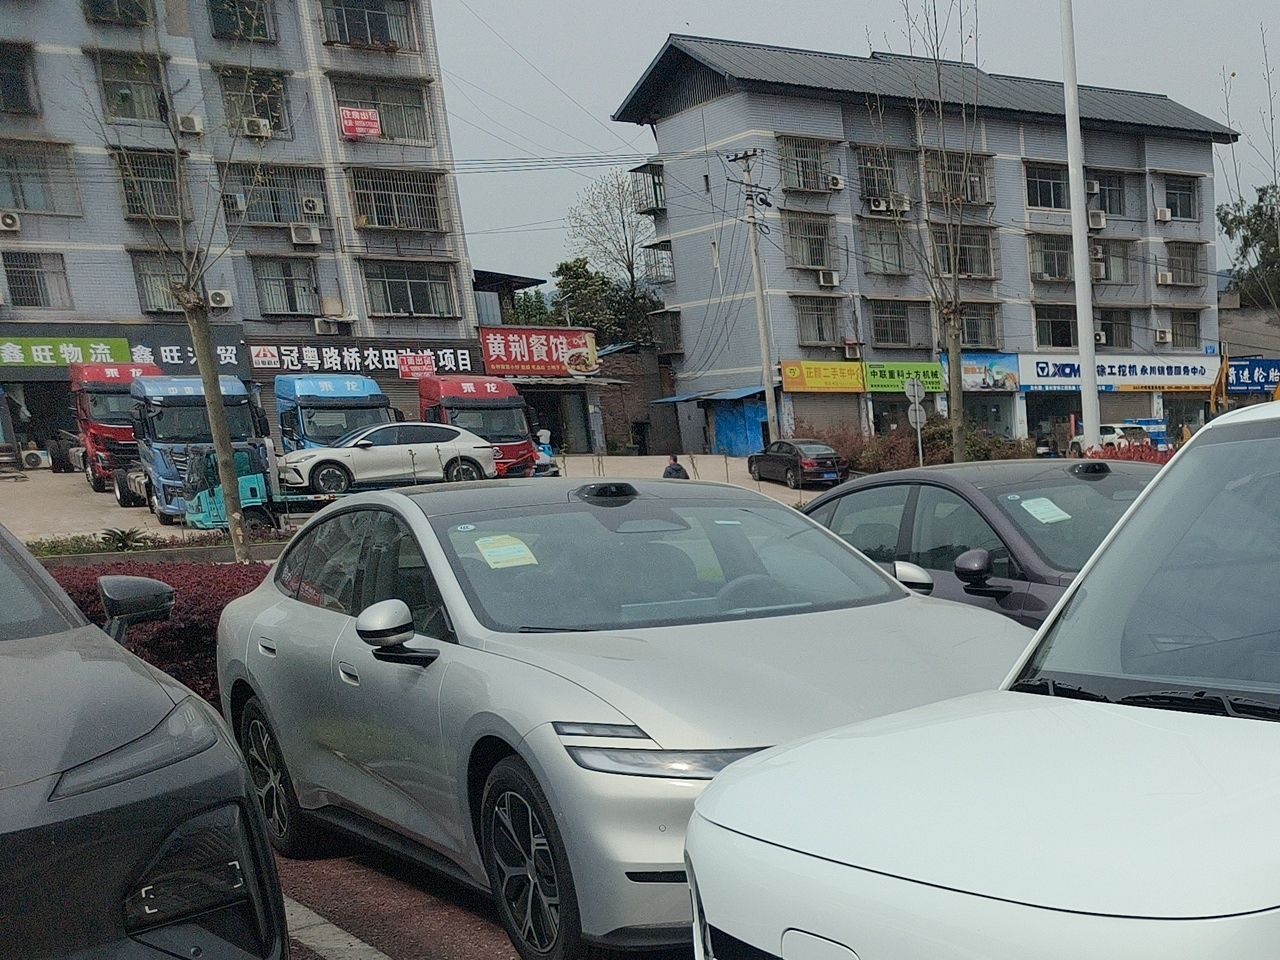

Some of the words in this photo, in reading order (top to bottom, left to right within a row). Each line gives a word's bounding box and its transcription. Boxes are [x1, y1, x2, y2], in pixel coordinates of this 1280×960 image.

[0, 342, 115, 364] 鑫旺物流
[280, 345, 472, 372] 冠粤路桥农田项目
[486, 333, 568, 362] 黄荆餐馆
